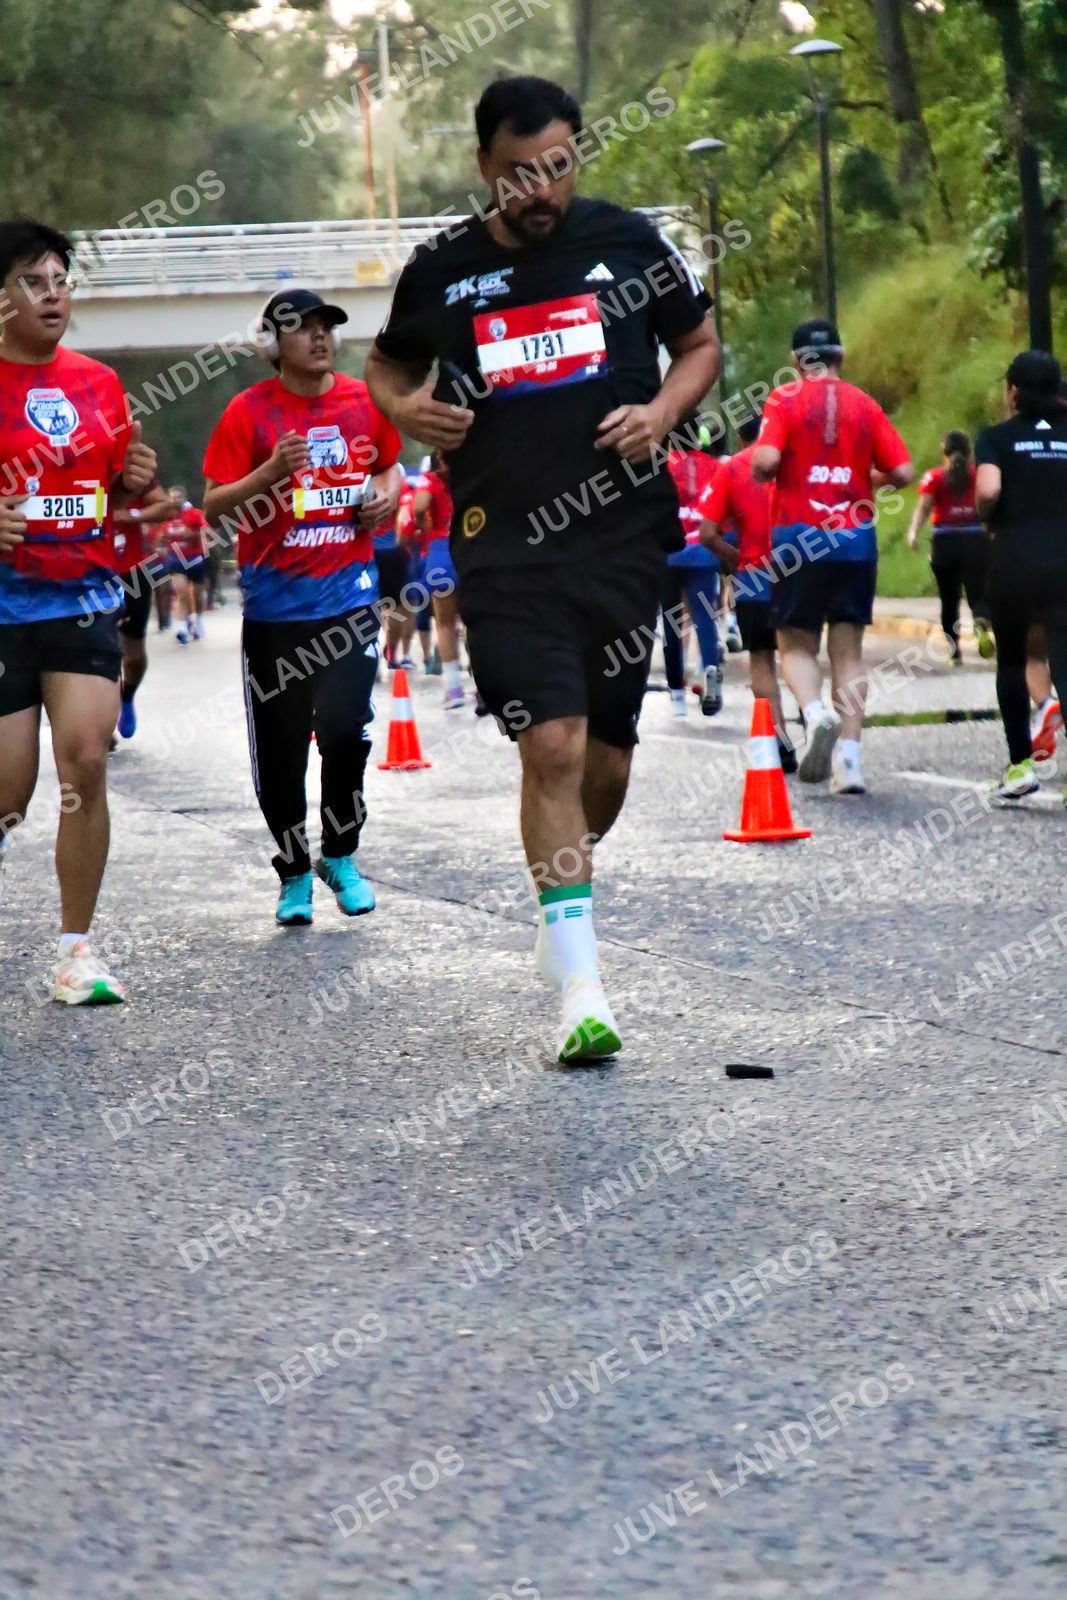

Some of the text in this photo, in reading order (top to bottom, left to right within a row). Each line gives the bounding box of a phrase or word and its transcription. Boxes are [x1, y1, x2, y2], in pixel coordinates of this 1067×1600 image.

[445, 274, 477, 306] 2K
[520, 332, 565, 361] 1731
[43, 496, 85, 518] 3205
[319, 487, 350, 507] 1347
